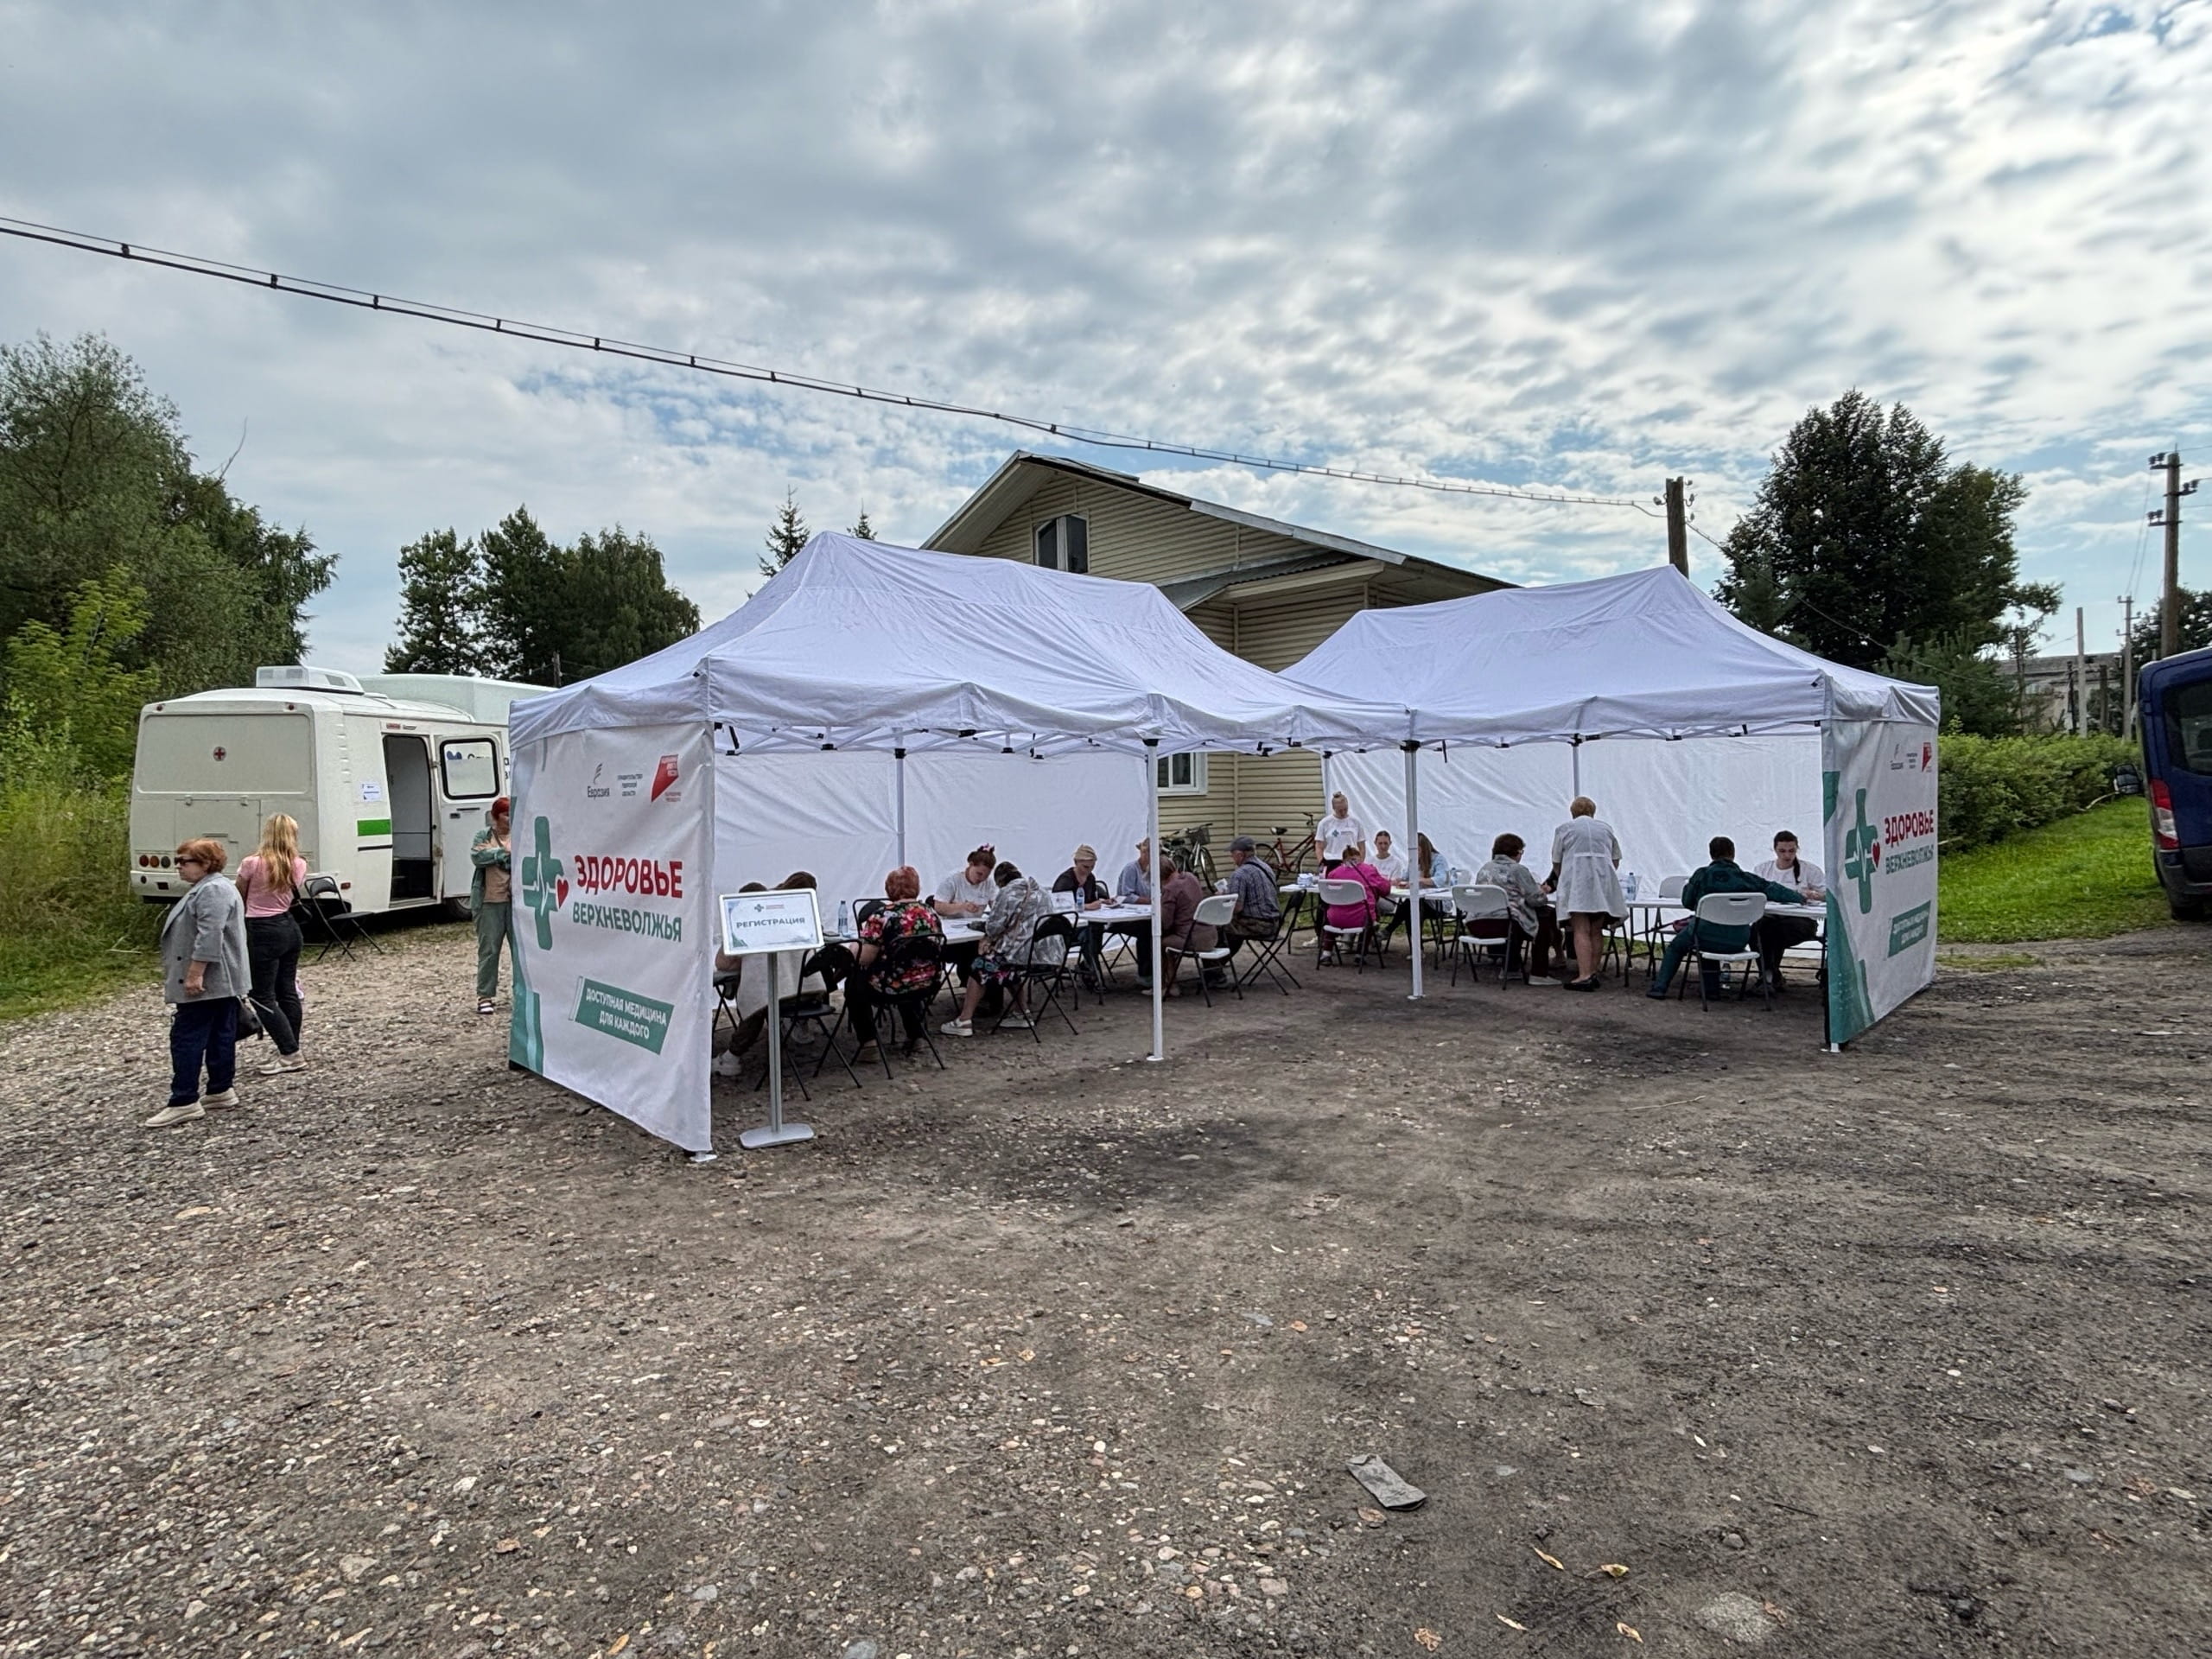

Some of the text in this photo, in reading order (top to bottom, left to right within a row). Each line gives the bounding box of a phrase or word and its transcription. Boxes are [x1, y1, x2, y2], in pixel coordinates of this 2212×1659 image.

[1885, 809, 1935, 849] ЗДОРОВЬЕ
[574, 855, 683, 899] ЗДОРОВЬЕ
[573, 901, 682, 943] ВЕРХНЕВОЛЖЬЯ
[736, 917, 805, 929] РЕГИСТРАЦИЯ
[586, 988, 667, 1026] ДОСТУПНАЯ МЕДИЦИНА
[599, 1010, 650, 1039] ДЛЯ КАЖДОГО
